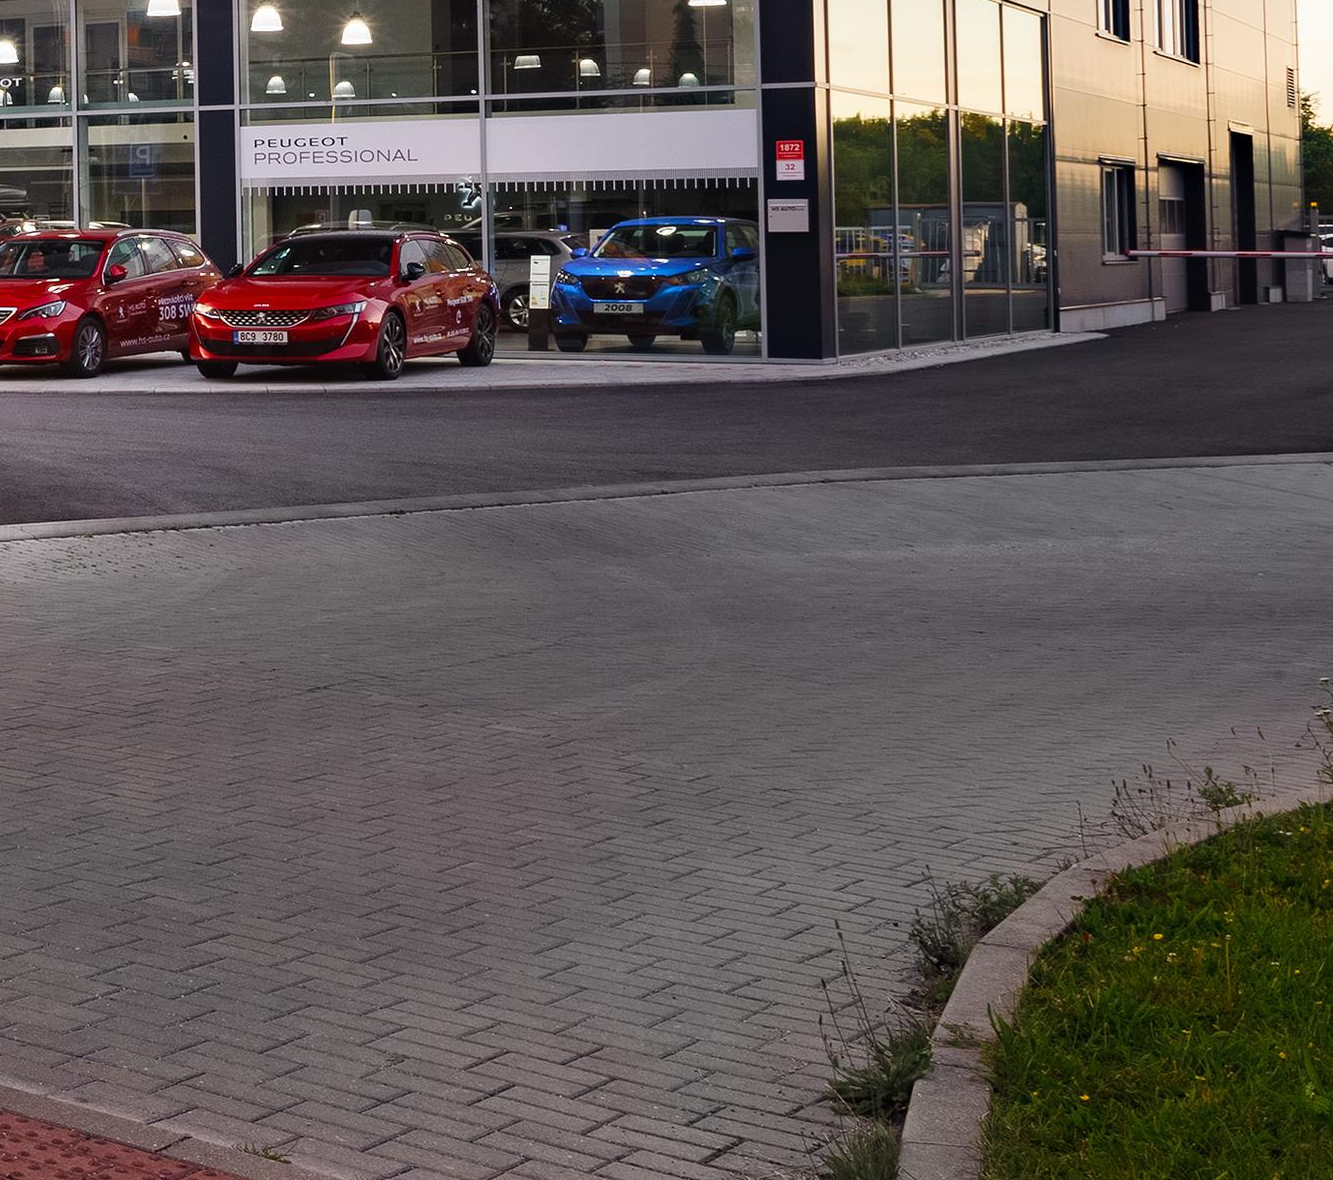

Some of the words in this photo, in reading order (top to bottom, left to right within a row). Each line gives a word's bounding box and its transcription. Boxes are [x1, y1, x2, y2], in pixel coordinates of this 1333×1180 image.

[254, 137, 348, 148] PEUGEOT
[254, 149, 419, 165] PROFESSIONAL
[159, 305, 177, 320] 308
[240, 332, 256, 340] 8C9
[262, 332, 284, 341] 3780
